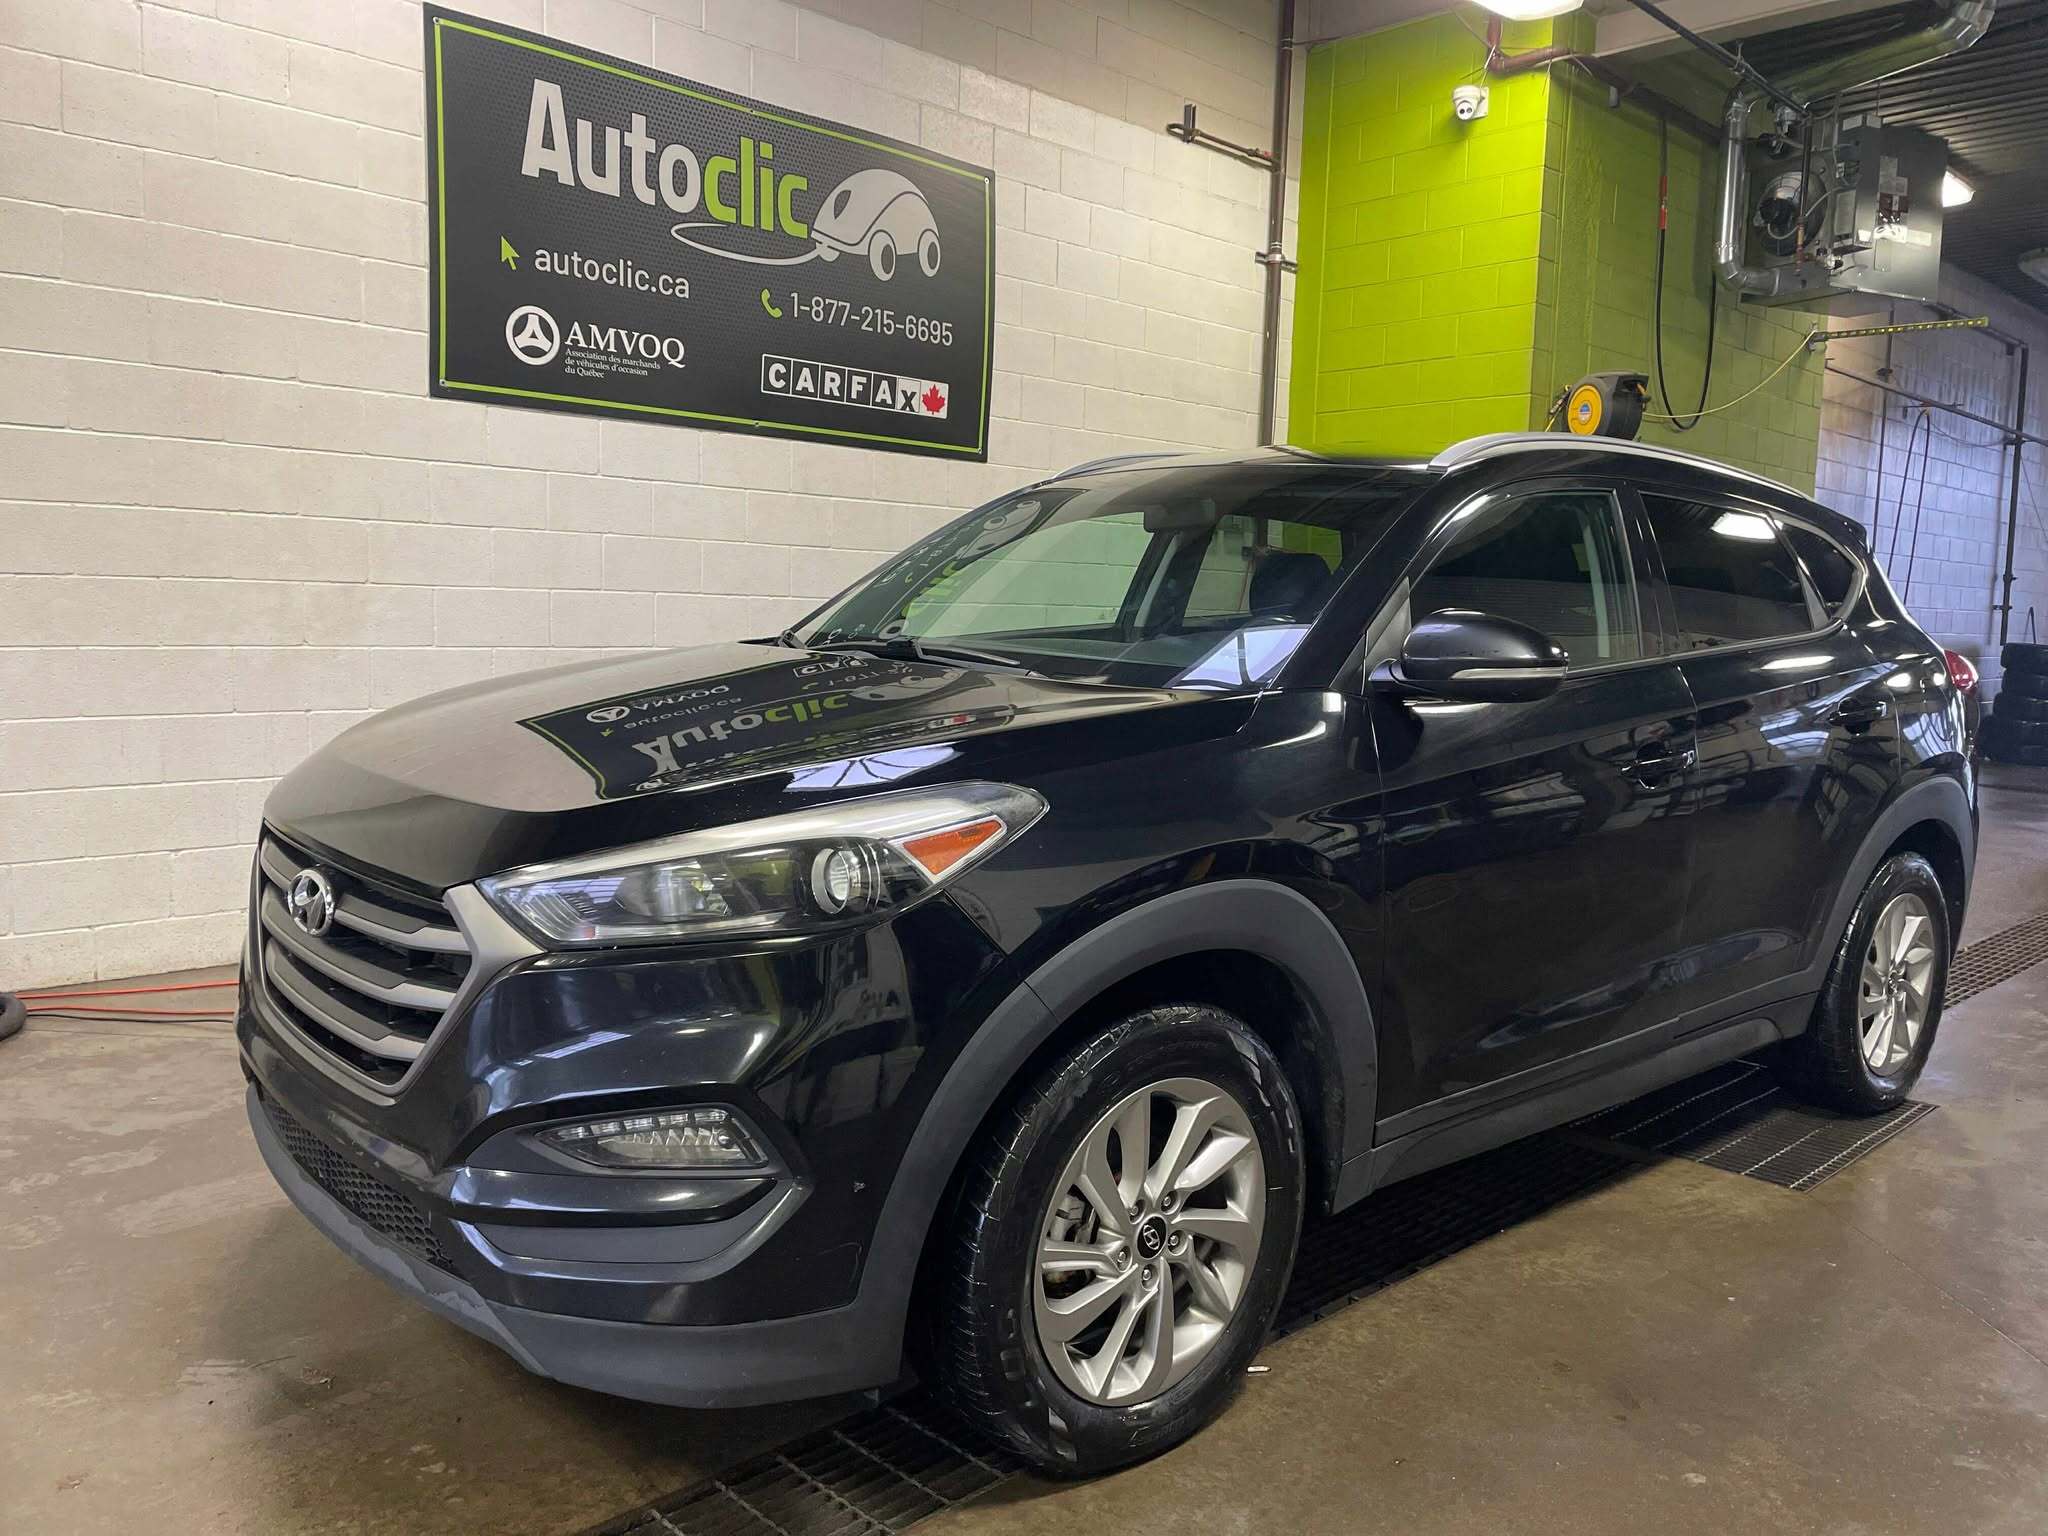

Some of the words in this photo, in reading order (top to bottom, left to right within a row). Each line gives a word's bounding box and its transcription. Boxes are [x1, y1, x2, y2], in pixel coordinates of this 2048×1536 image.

[521, 78, 808, 239] Autoclic
[534, 248, 690, 299] autoclic.ca
[790, 292, 953, 346] 1-877-215-6695
[564, 320, 686, 369] AMVOQ
[564, 356, 575, 365] de
[576, 357, 610, 371] véhicules
[611, 363, 648, 376] d'occasion
[565, 347, 607, 361] Association
[608, 353, 621, 363] des
[622, 357, 661, 370] marchands
[564, 366, 576, 375] du
[576, 367, 604, 378] Québec
[768, 362, 917, 413] CARFAX
